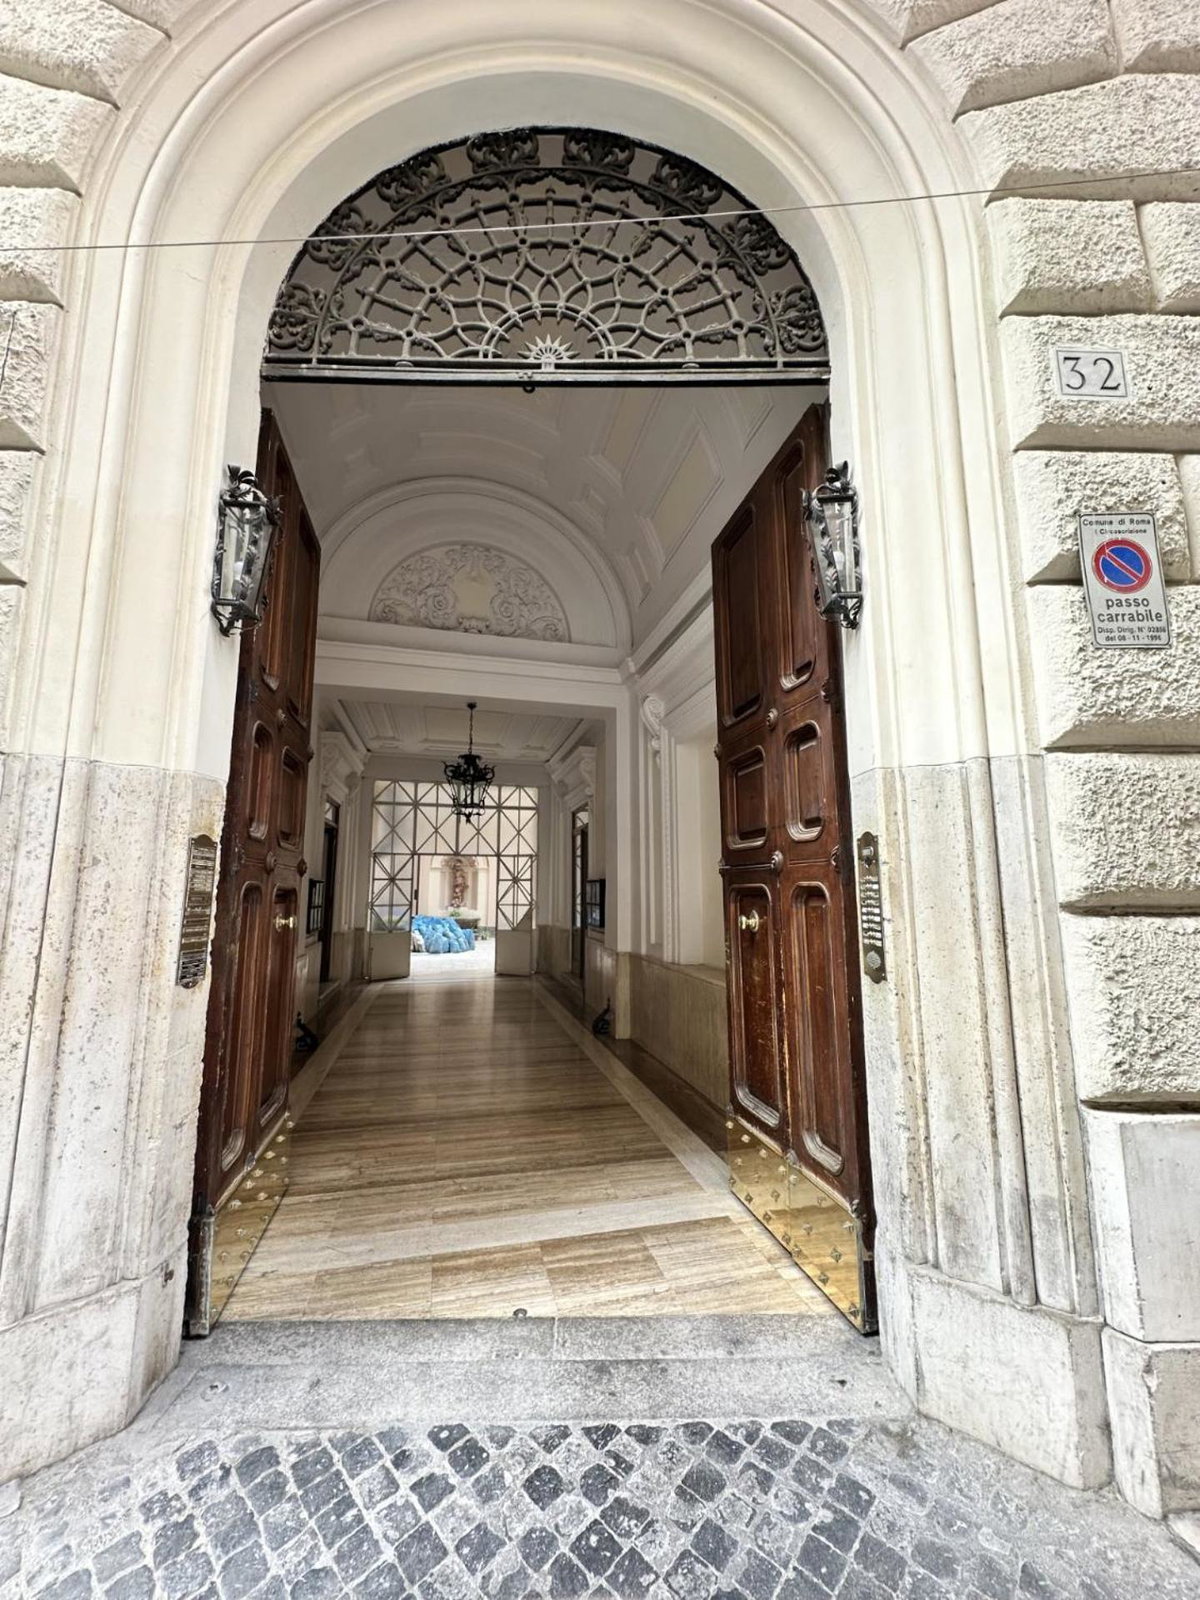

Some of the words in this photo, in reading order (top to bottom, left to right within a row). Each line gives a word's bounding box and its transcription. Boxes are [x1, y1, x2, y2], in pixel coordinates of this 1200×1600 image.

[1063, 357, 1121, 390] 32
[1082, 518, 1113, 526] Comune
[1118, 518, 1126, 526] di
[1129, 517, 1151, 525] Roma
[1105, 598, 1150, 610] passo
[1097, 609, 1163, 622] carrabile
[1097, 626, 1116, 634] Disp.
